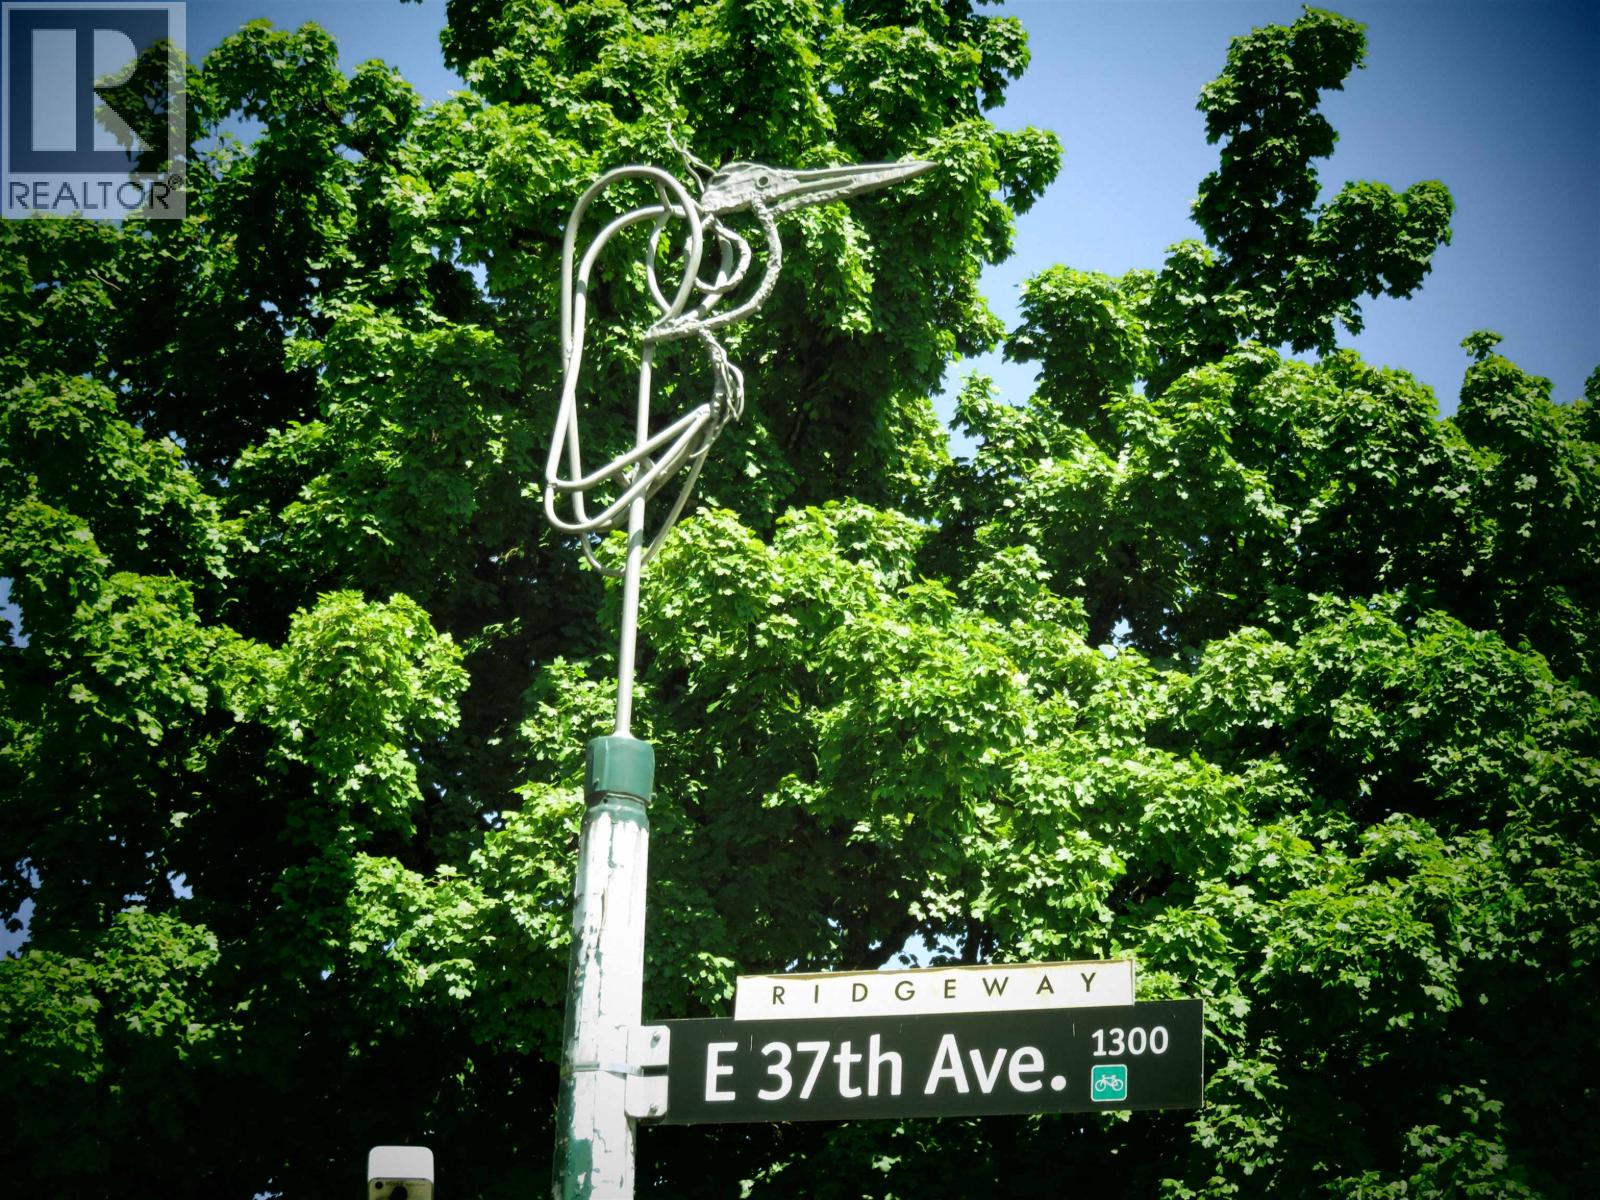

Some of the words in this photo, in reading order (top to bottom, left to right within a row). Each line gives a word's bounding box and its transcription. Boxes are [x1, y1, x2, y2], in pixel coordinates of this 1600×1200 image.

[773, 972, 1096, 1005] RIDGEWAY
[1091, 1025, 1169, 1057] 1300
[705, 1041, 738, 1102] E
[758, 1033, 903, 1100] 37th
[924, 1032, 1068, 1095] Ave.
